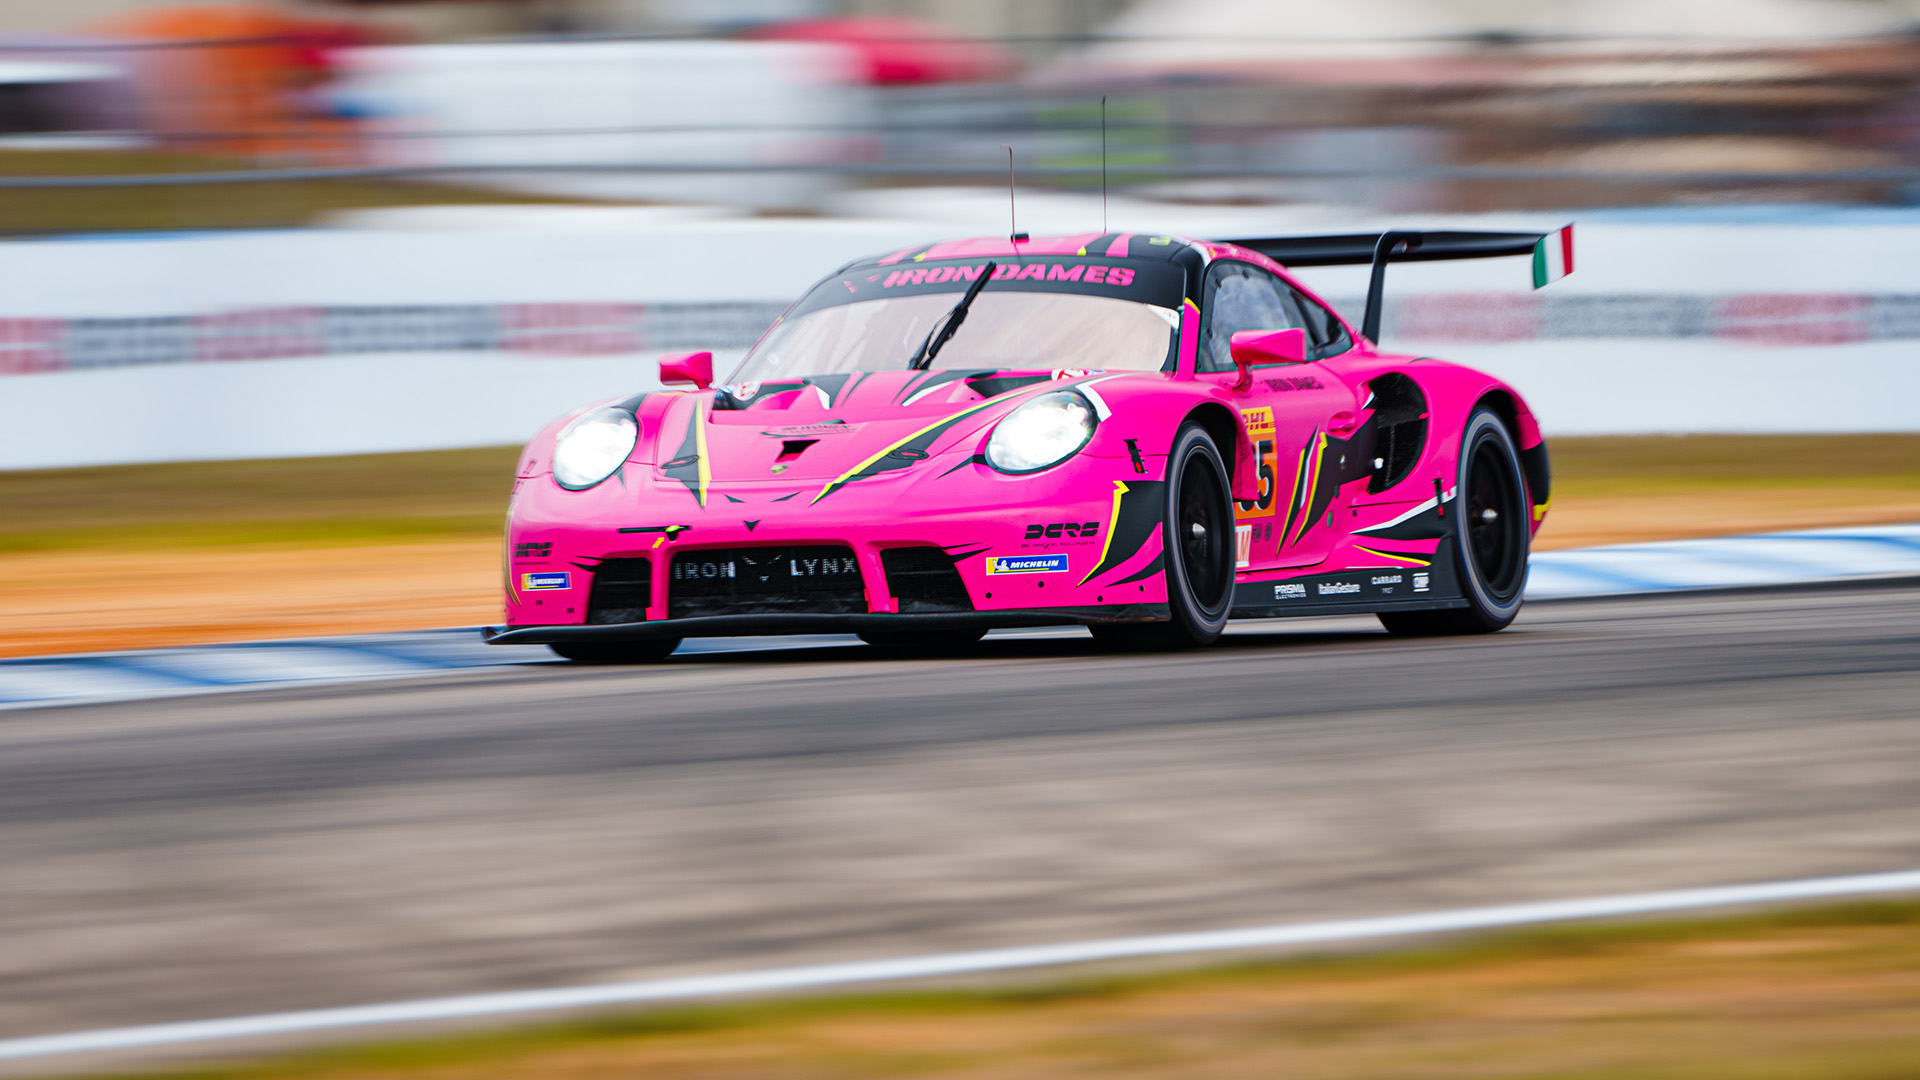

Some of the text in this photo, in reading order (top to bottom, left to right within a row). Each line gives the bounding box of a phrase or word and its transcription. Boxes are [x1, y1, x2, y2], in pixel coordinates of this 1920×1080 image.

[882, 263, 1136, 289] IRON DAMES
[674, 557, 856, 579] IRON LYNX
[1010, 560, 1059, 569] MICHELIN
[1274, 583, 1306, 594] PRISMA
